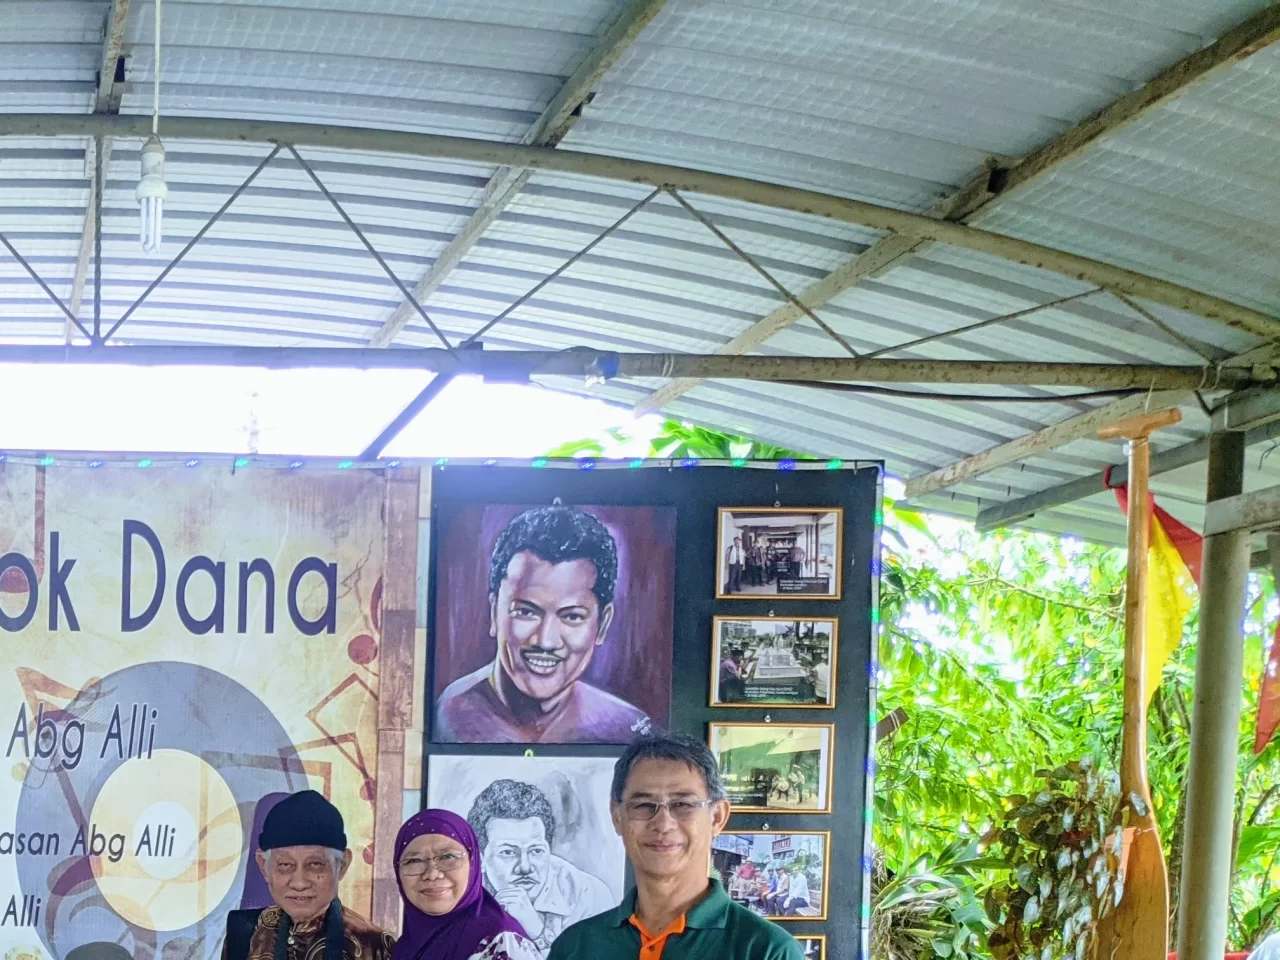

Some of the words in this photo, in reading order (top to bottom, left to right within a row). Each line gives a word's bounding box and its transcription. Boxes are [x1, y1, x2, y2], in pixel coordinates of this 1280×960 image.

[120, 519, 338, 636] Dana
[5, 702, 86, 770] Abg
[99, 703, 158, 760] Alli
[70, 823, 126, 863] Abg
[134, 824, 177, 858] Alli
[0, 894, 42, 927] Alli
